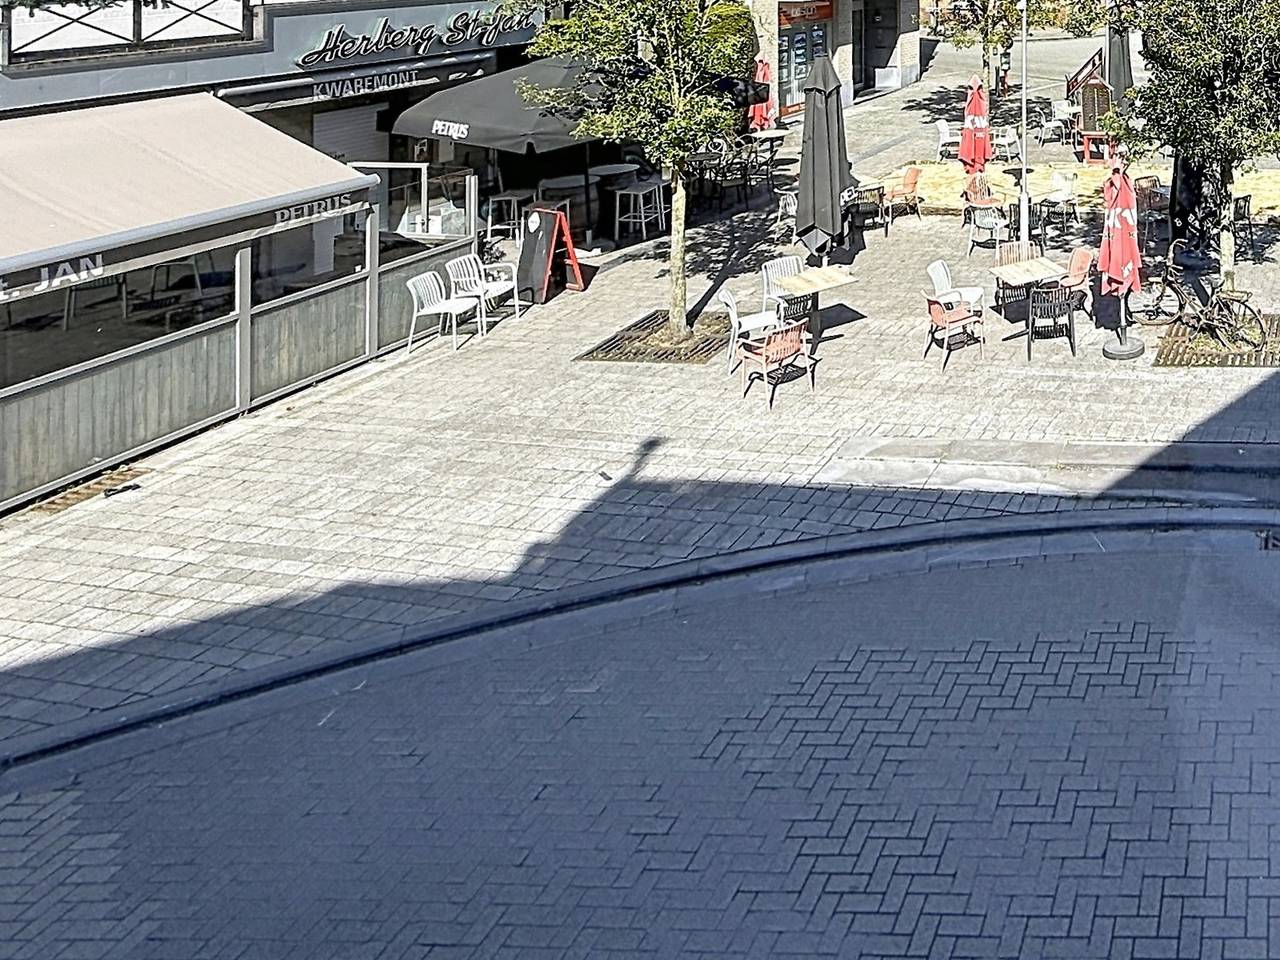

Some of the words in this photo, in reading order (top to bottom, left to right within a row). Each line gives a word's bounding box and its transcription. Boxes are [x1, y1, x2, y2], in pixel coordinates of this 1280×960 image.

[299, 17, 437, 66] Herberg
[312, 70, 419, 100] KWAREMONT
[432, 120, 469, 139] PETRUS
[274, 193, 352, 224] PETRUS
[34, 254, 104, 292] JAN
